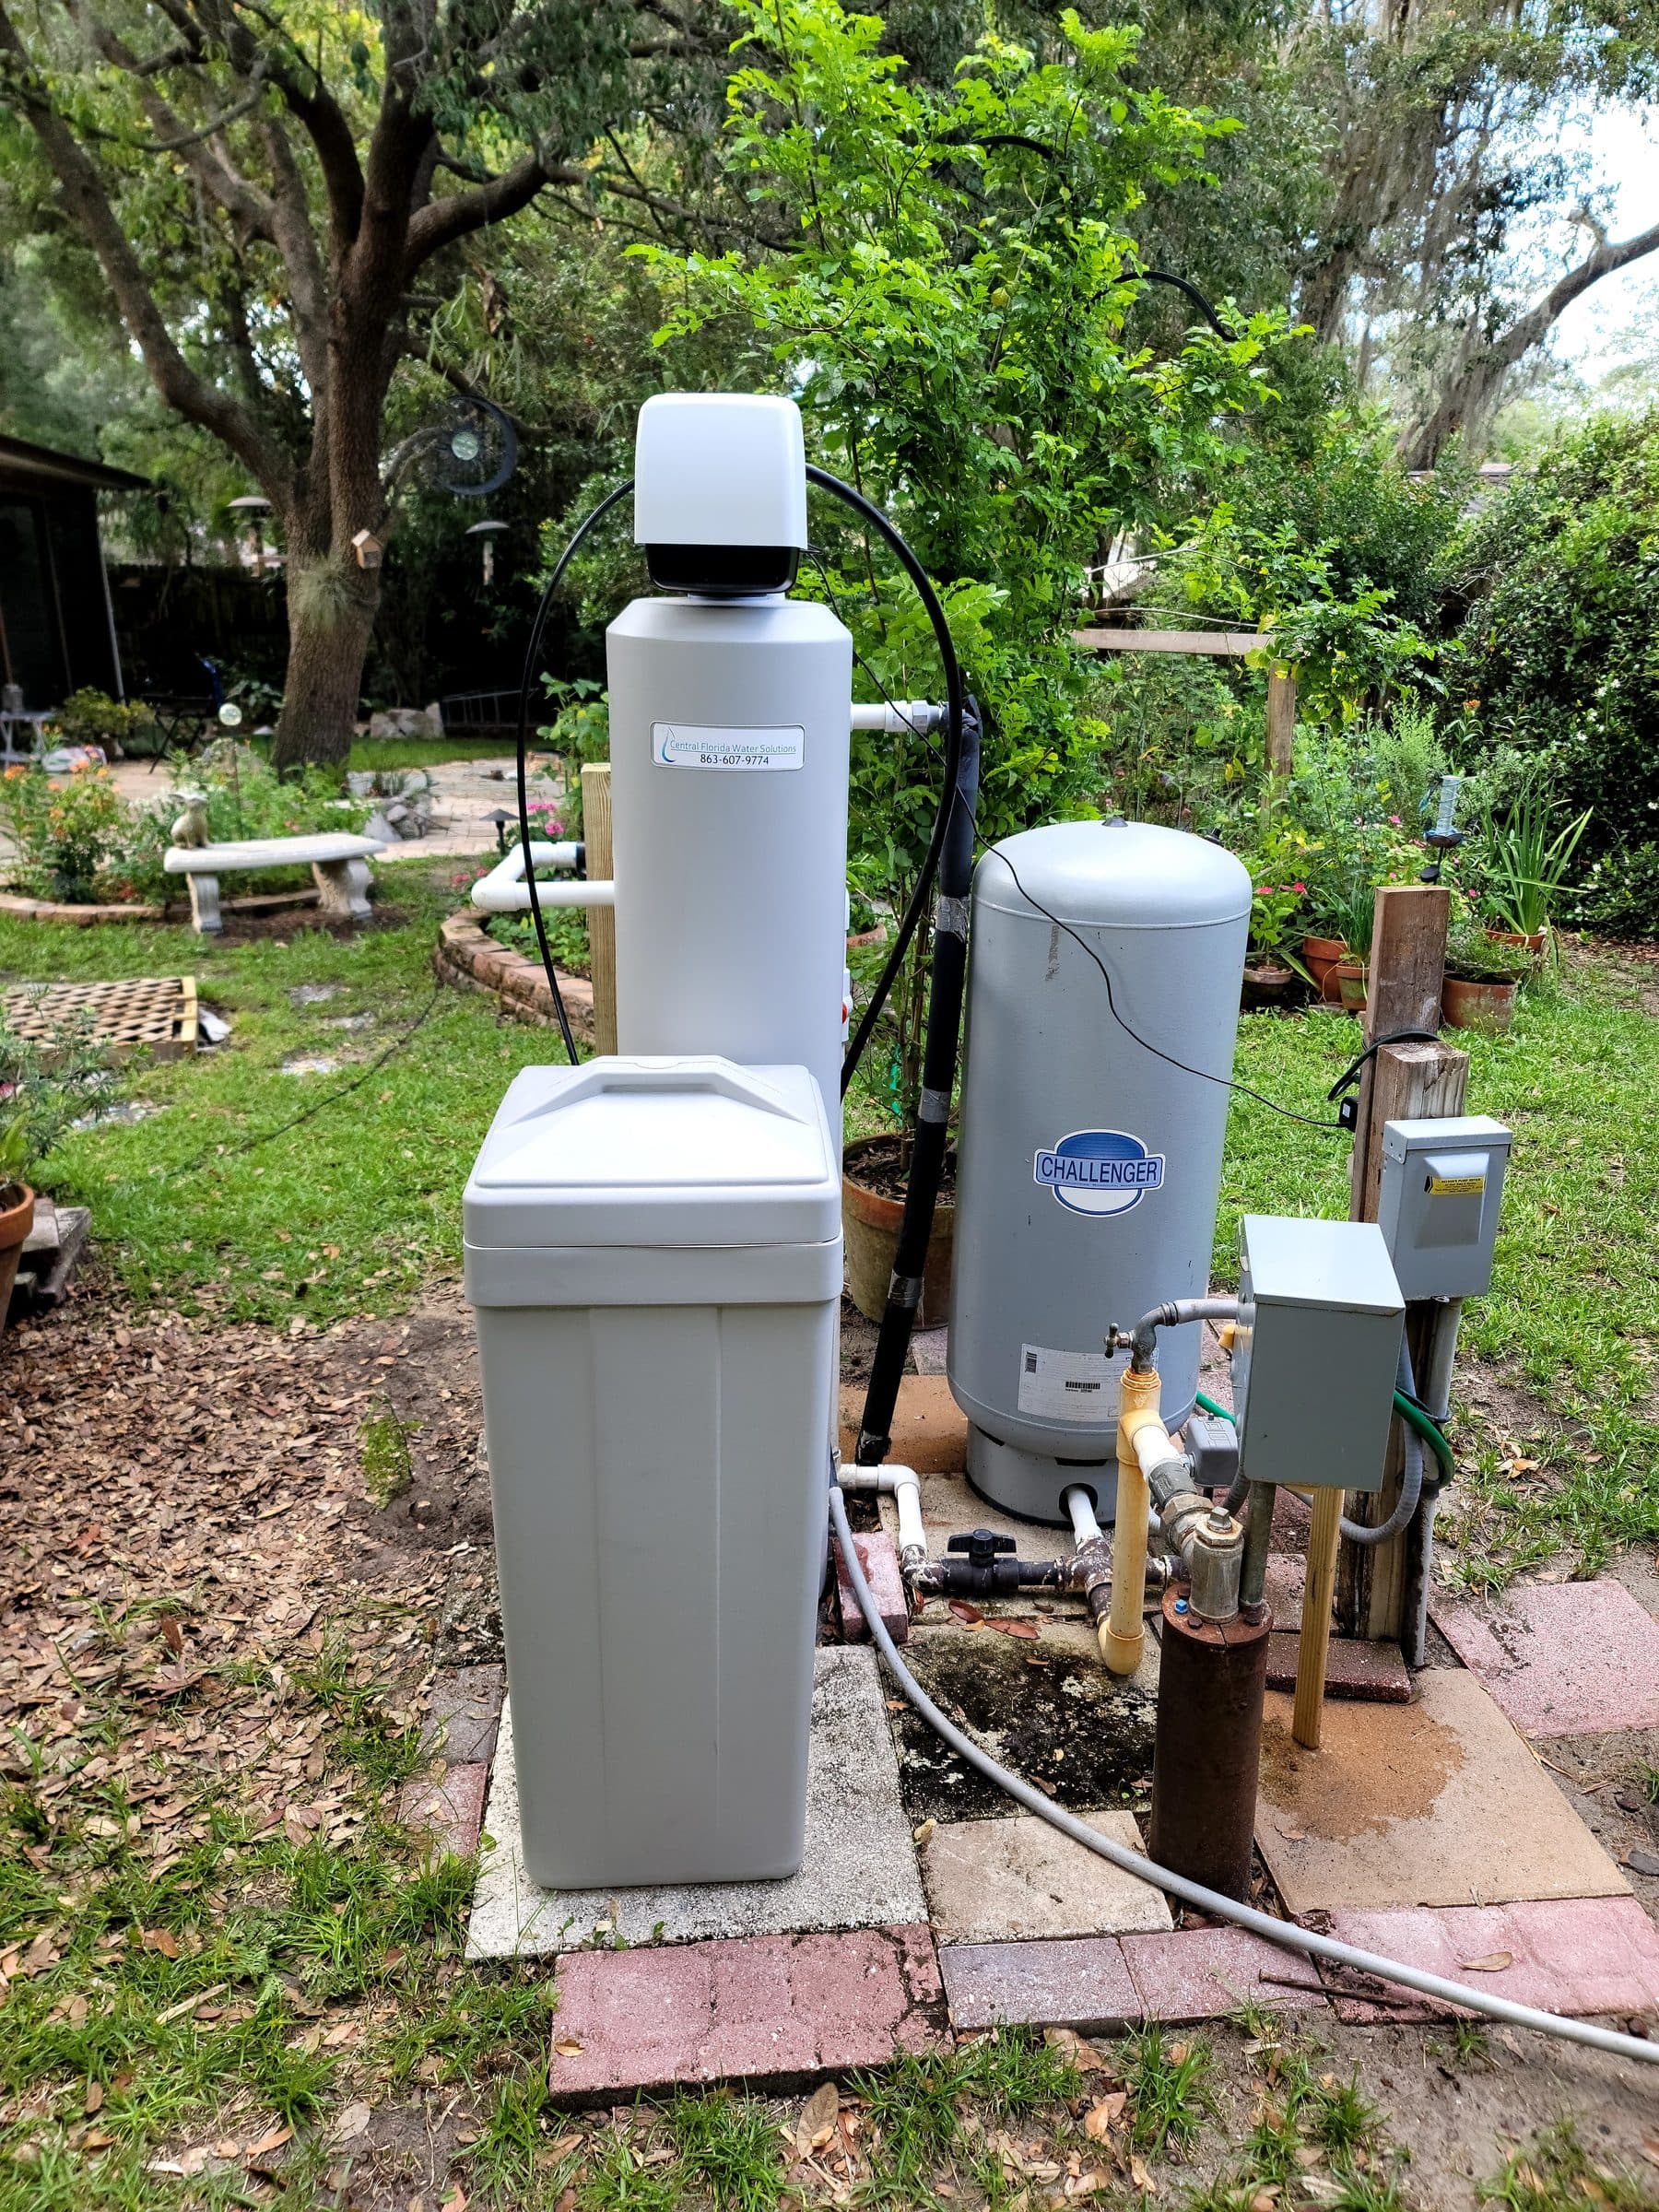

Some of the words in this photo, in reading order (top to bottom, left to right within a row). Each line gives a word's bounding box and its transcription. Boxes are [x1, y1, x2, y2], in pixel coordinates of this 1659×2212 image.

[670, 740, 699, 751] Central
[701, 742, 731, 752] Florida
[732, 744, 759, 753] Water
[759, 744, 796, 753] Solutions
[700, 754, 769, 765] 863-607-9774
[1041, 1157, 1158, 1183] CHALLENGER
